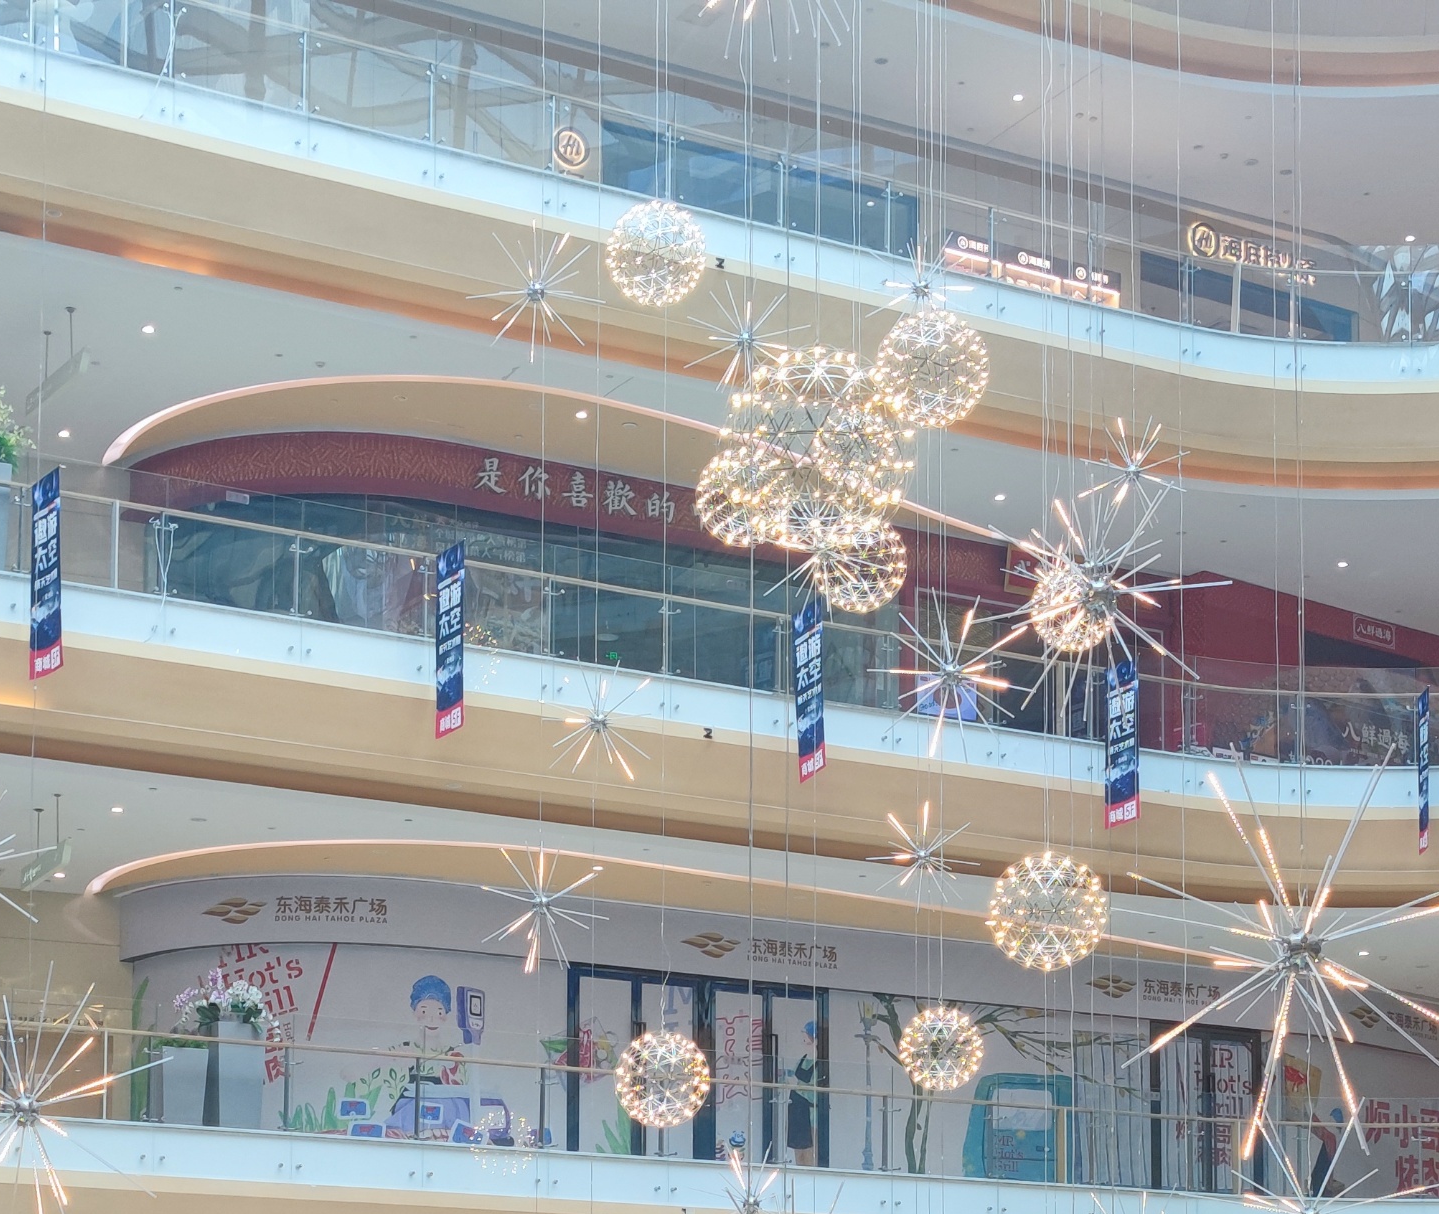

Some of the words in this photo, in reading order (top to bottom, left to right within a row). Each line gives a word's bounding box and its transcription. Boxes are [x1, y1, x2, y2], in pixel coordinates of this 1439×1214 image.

[476, 457, 677, 523] 是你喜歡的
[1357, 623, 1393, 642] 八鮮過海
[275, 896, 388, 916] 东海泰禾广场
[325, 915, 355, 923] TAHOE
[359, 916, 388, 924] PLAZA
[748, 938, 837, 963] 东海泰禾广场
